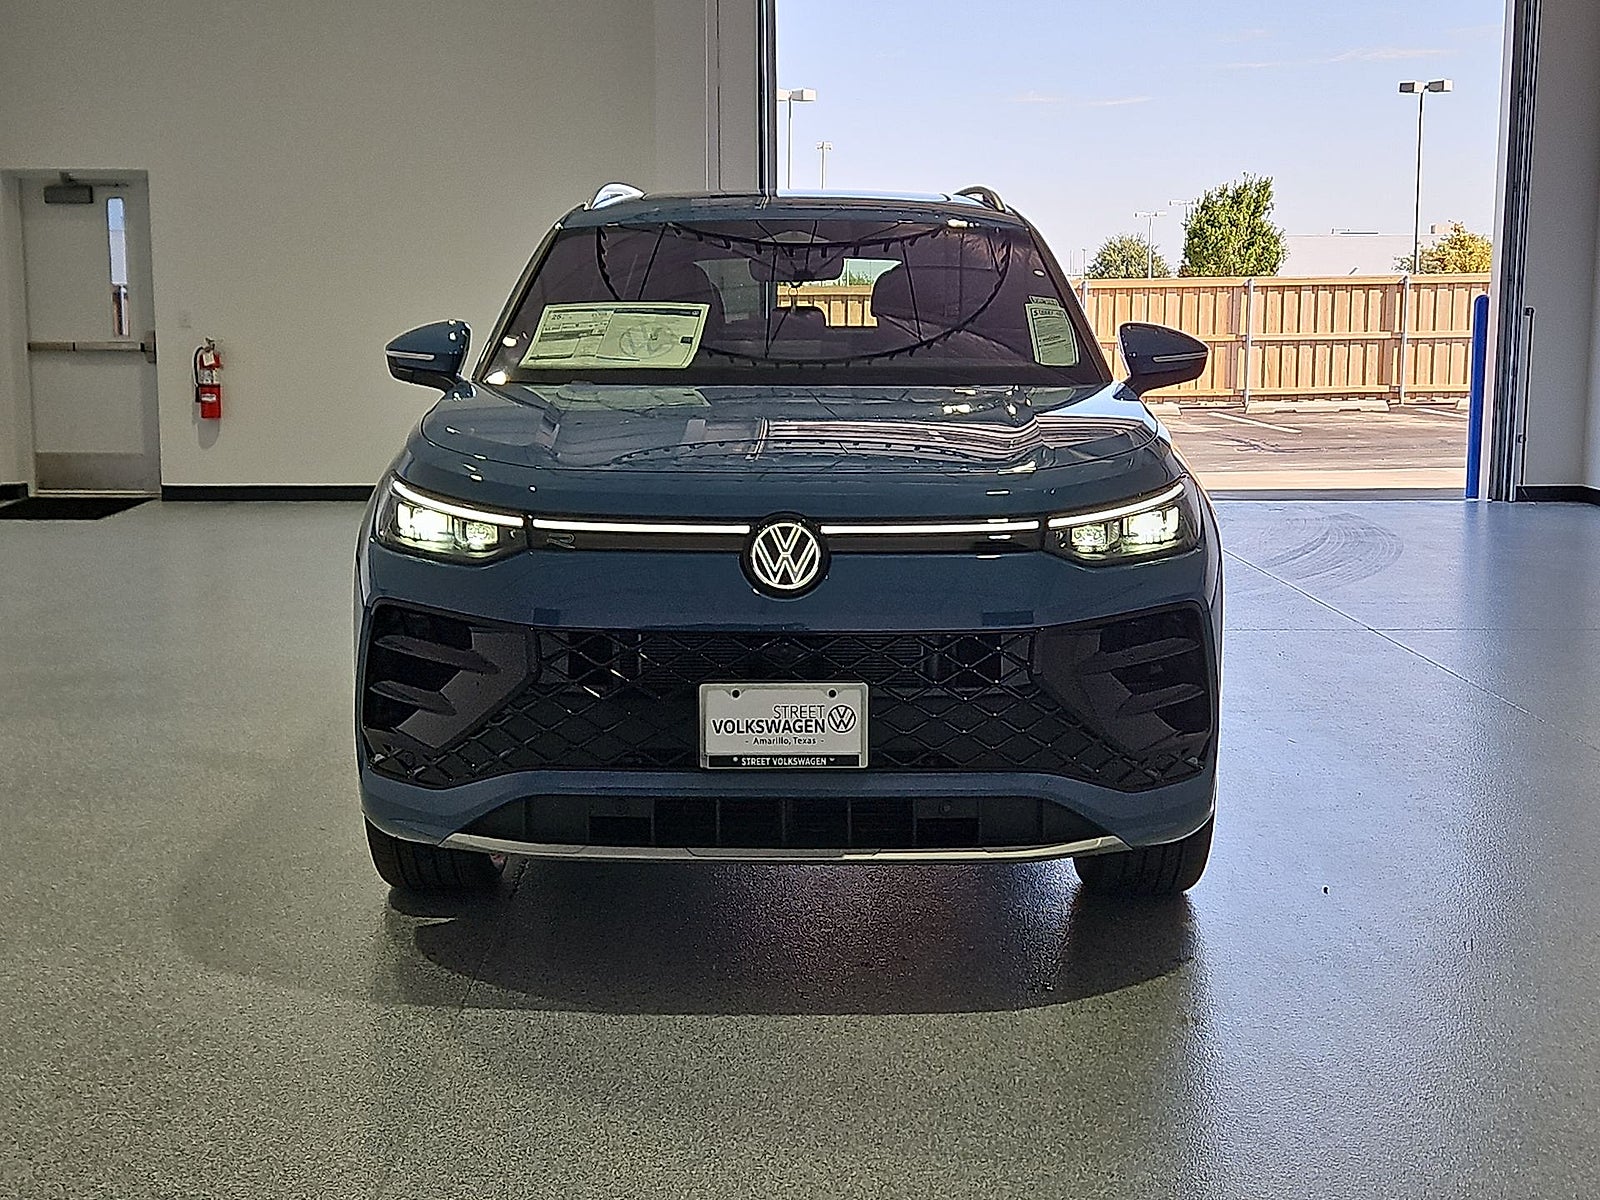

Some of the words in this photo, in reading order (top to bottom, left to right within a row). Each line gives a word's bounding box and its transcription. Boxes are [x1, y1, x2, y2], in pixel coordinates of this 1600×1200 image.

[752, 522, 820, 589] VW
[773, 705, 825, 719] STREET
[827, 704, 857, 734] VW
[712, 719, 826, 734] VOLKSWAGEN
[753, 737, 792, 745] Amarillo,
[793, 737, 817, 745] Texas
[741, 757, 771, 766] STREET
[772, 757, 827, 766] VOLKSWAGEN
